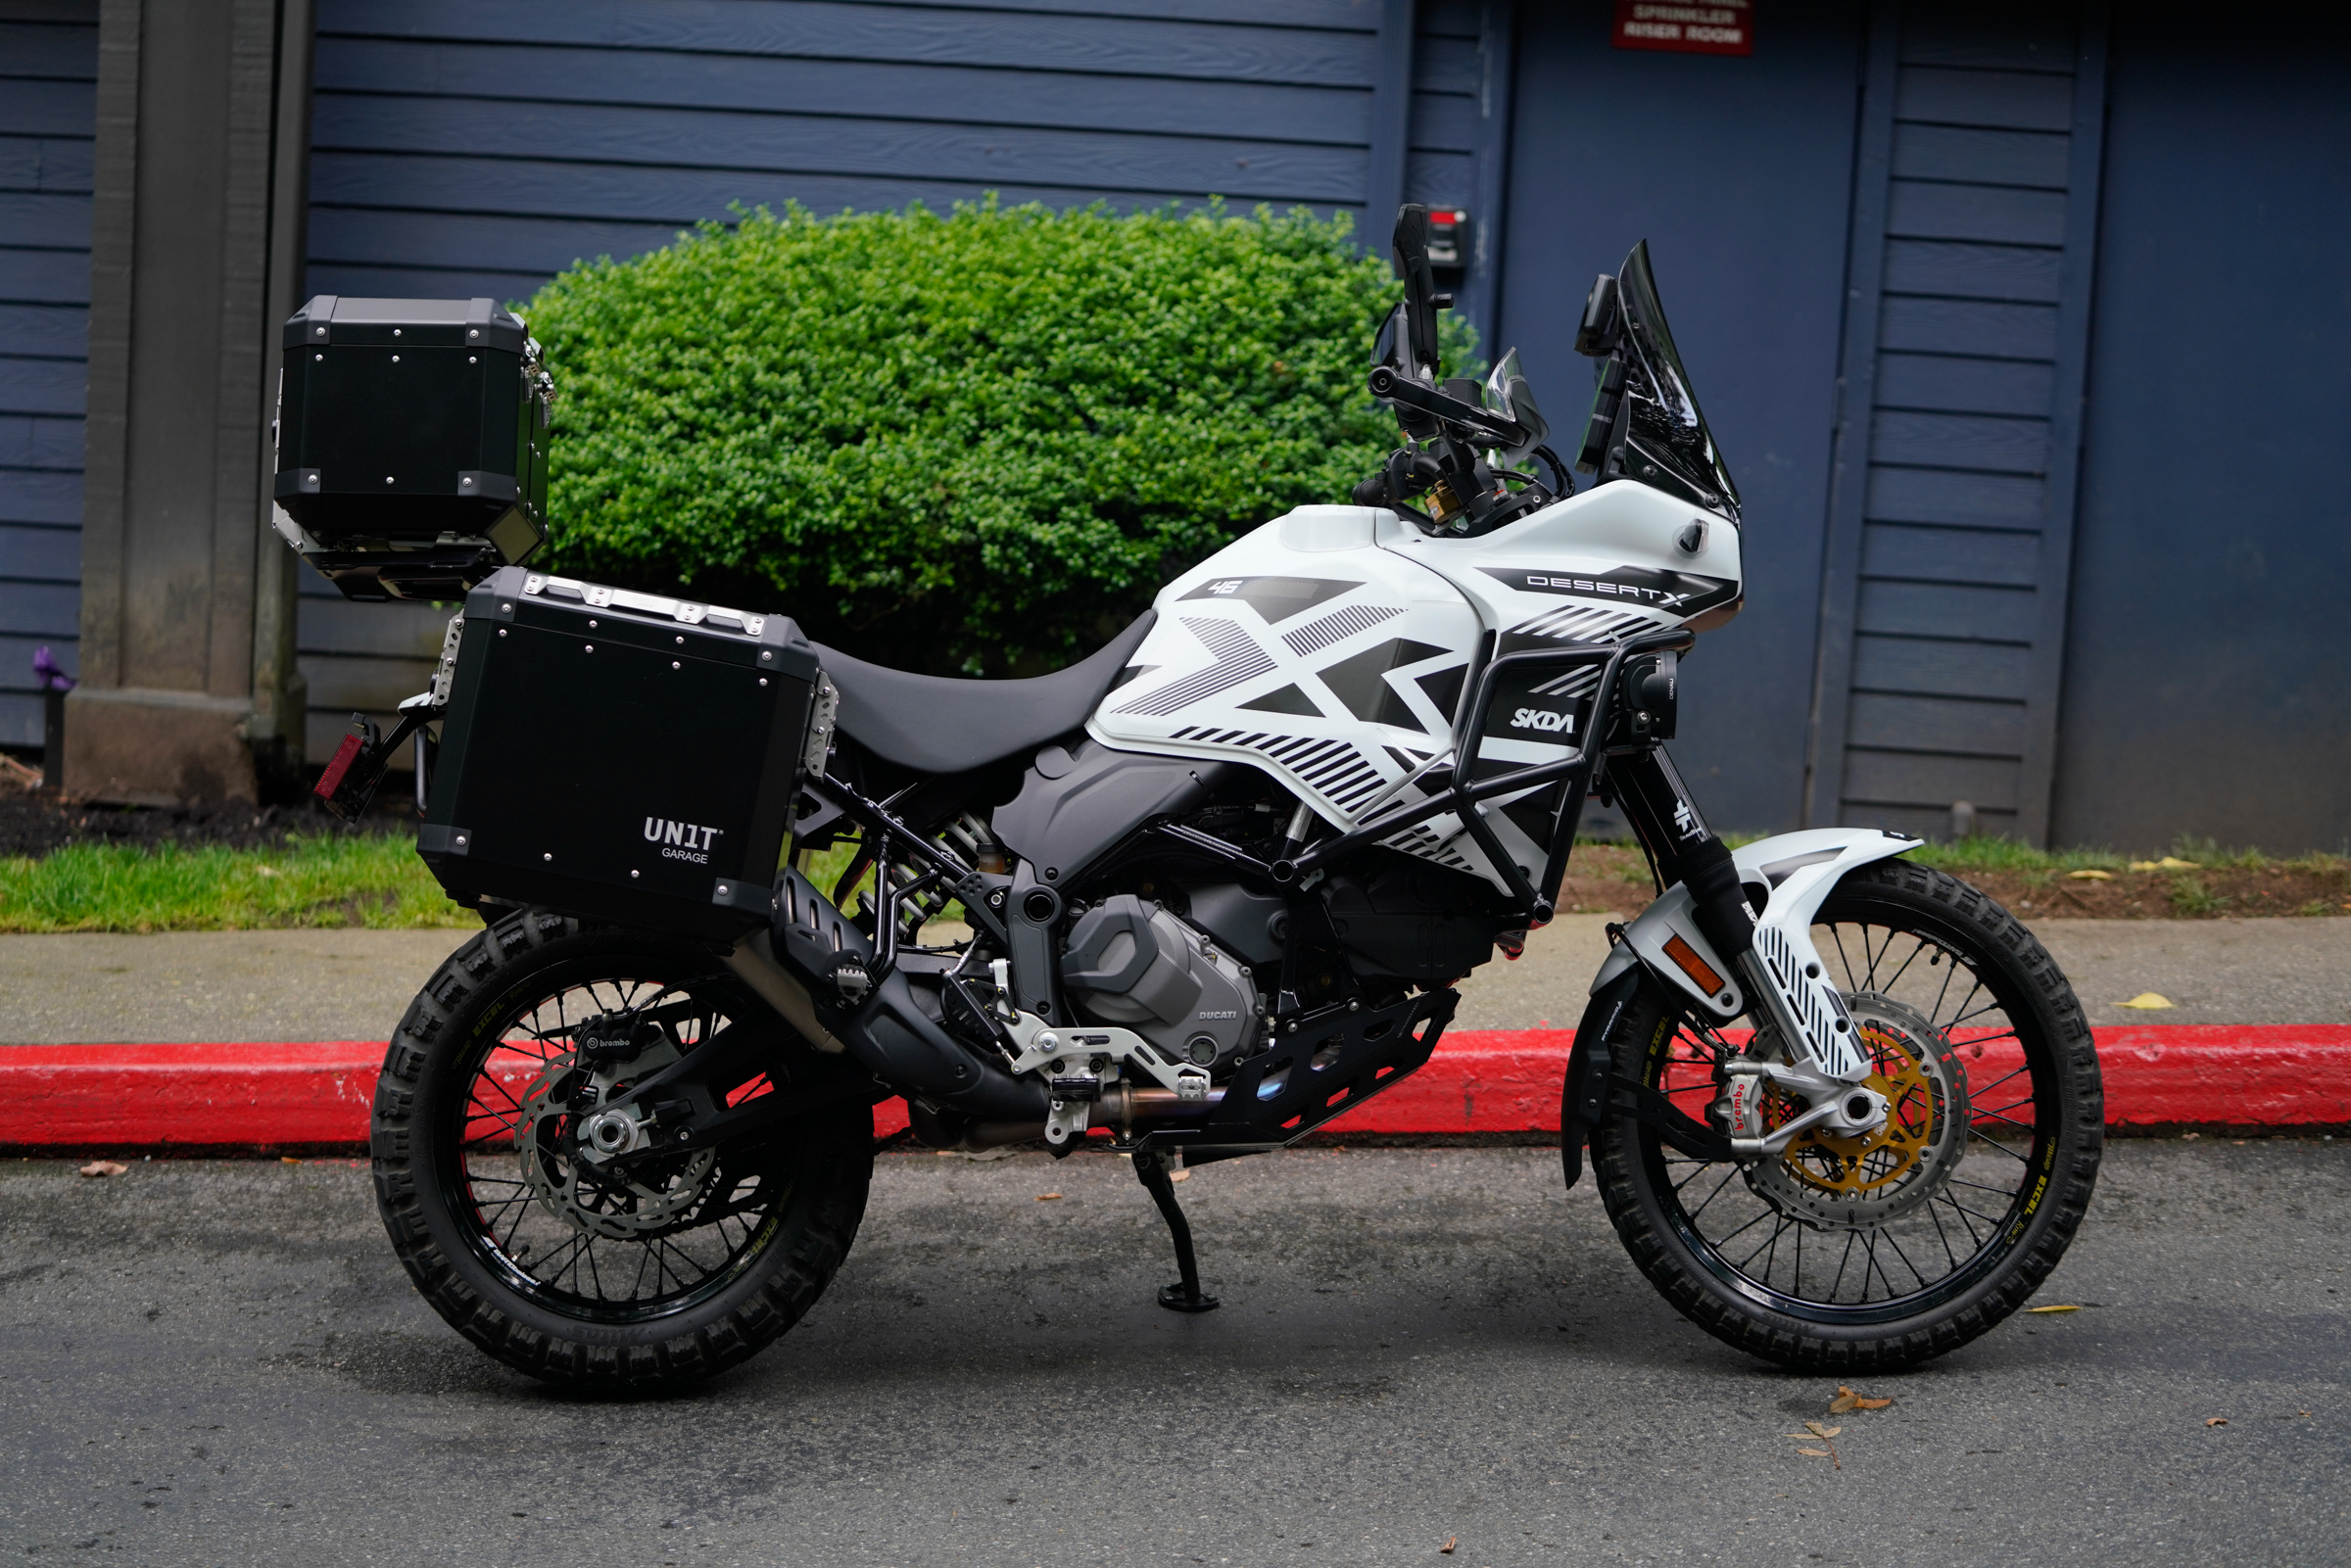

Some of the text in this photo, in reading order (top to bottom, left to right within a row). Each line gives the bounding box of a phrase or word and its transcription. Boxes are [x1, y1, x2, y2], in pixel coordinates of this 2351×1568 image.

[1632, 4, 1736, 25] SPRINKLER
[1623, 21, 1744, 45] RISER ROOM
[1207, 580, 1243, 594] 46
[1510, 708, 1575, 735] SKDA
[661, 847, 708, 864] GARAGE
[471, 1002, 505, 1037] EXCEL
[1198, 1011, 1236, 1021] DUCATI
[600, 1038, 630, 1047] brembo
[1649, 1015, 1670, 1056] EXCEL
[1733, 1083, 1745, 1130] brembo
[2024, 1174, 2047, 1215] EXCEL
[750, 1216, 779, 1254] EXCEL
